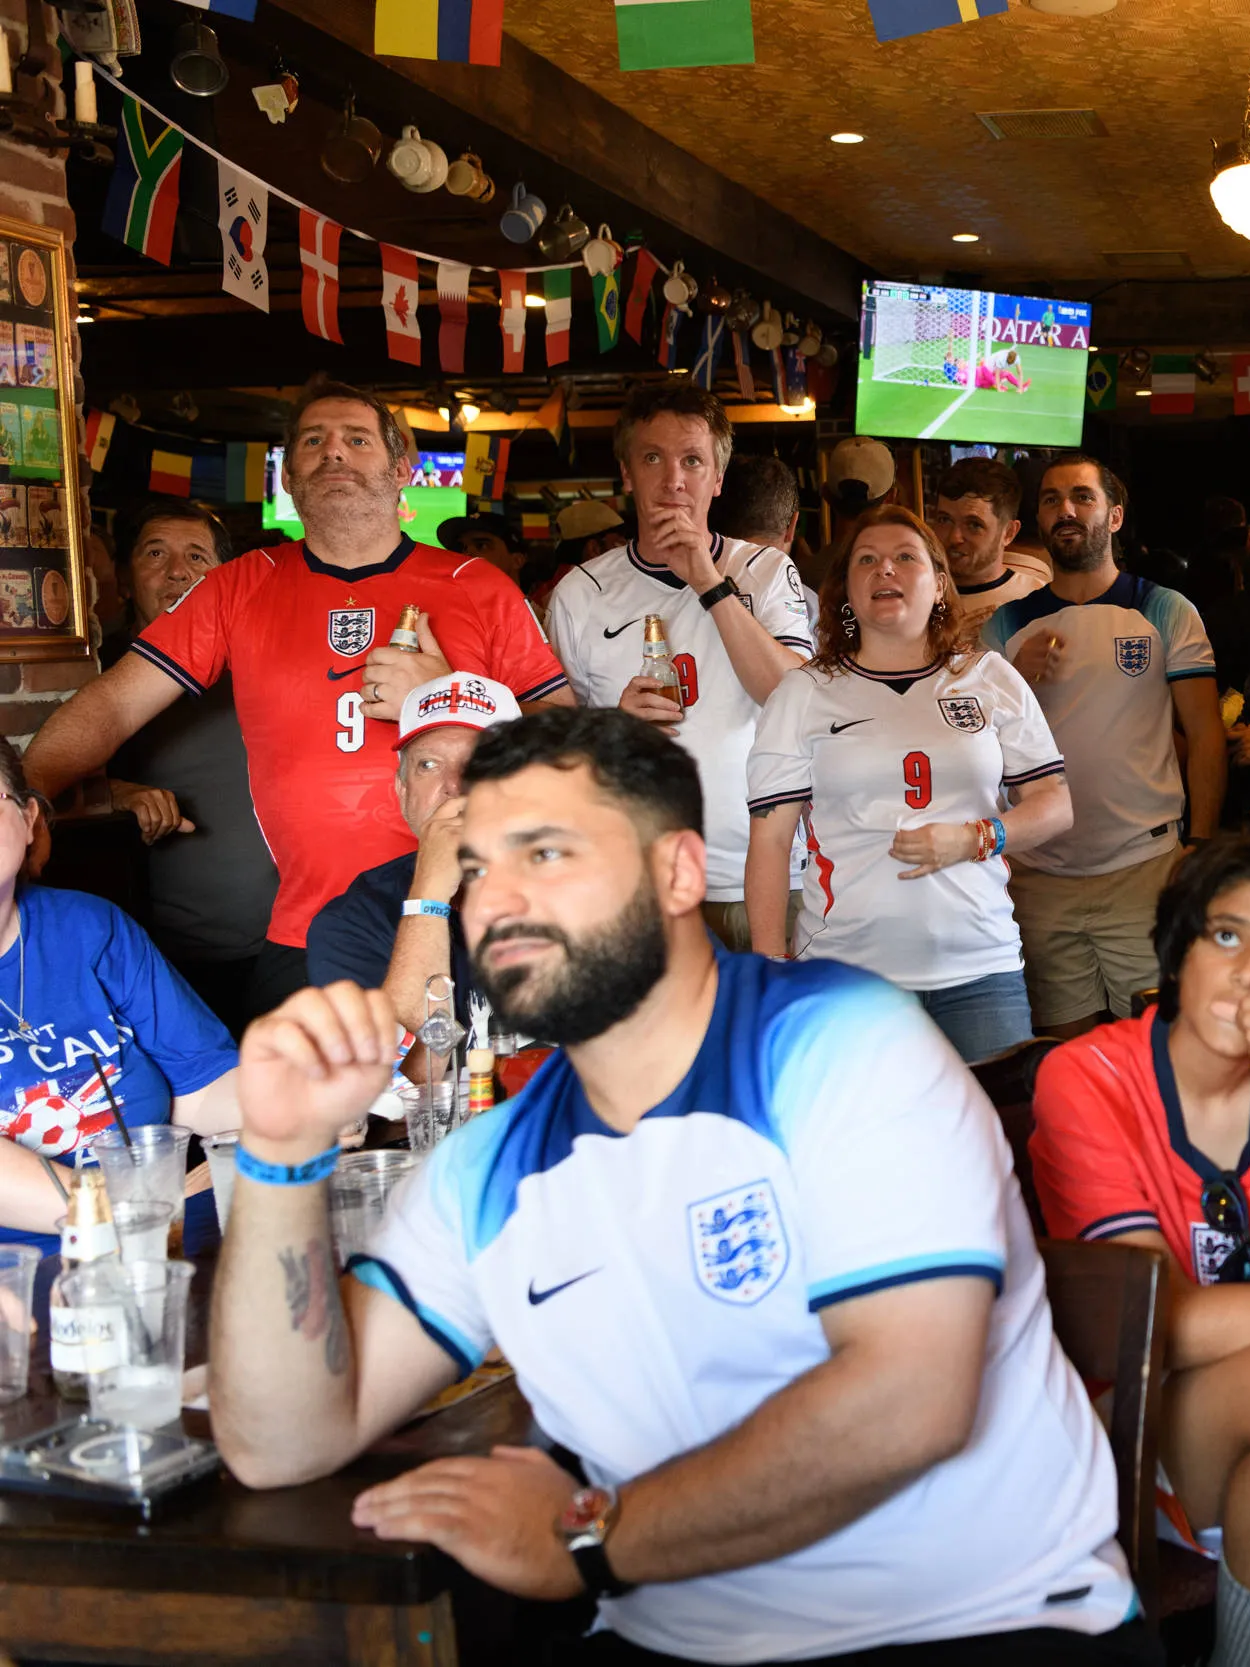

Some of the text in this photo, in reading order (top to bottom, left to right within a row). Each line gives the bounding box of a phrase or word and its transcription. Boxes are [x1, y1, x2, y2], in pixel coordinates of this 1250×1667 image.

[418, 689, 497, 718] ENGLAND
[672, 652, 699, 707] 9
[336, 691, 365, 753] 9
[903, 751, 933, 810] 9
